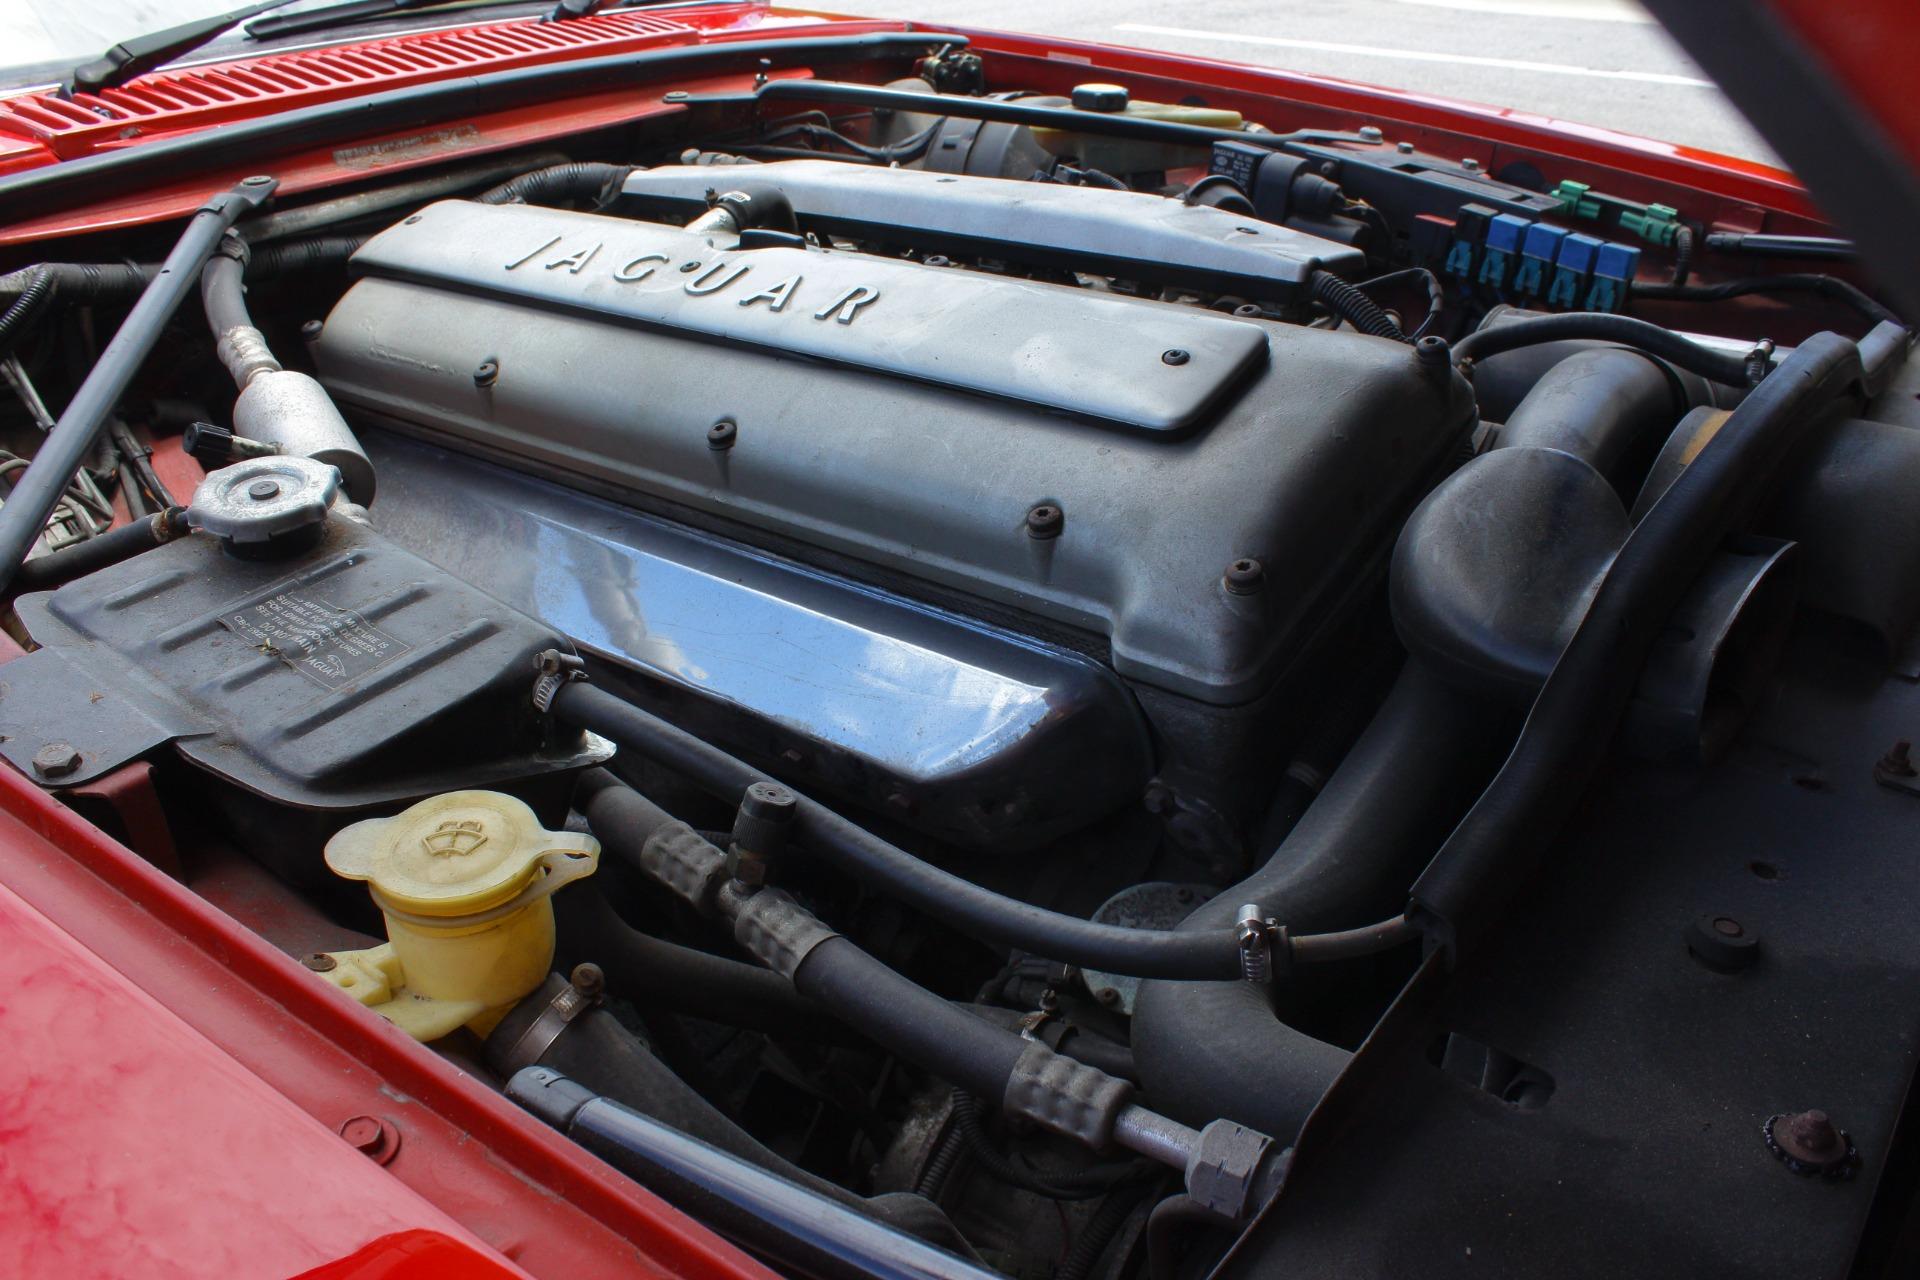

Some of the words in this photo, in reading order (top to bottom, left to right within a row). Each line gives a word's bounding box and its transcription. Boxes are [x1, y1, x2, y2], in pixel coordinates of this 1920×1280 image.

[505, 236, 881, 325] JAGUAR
[255, 605, 273, 618] SEE
[271, 616, 289, 627] THE
[265, 599, 283, 612] FOR
[281, 609, 308, 626] LOWER
[276, 595, 312, 617] SUITABLE
[340, 629, 376, 653] DEGREES
[259, 622, 275, 632] DO
[377, 640, 389, 649] IS
[304, 655, 340, 678] JAGUAR
